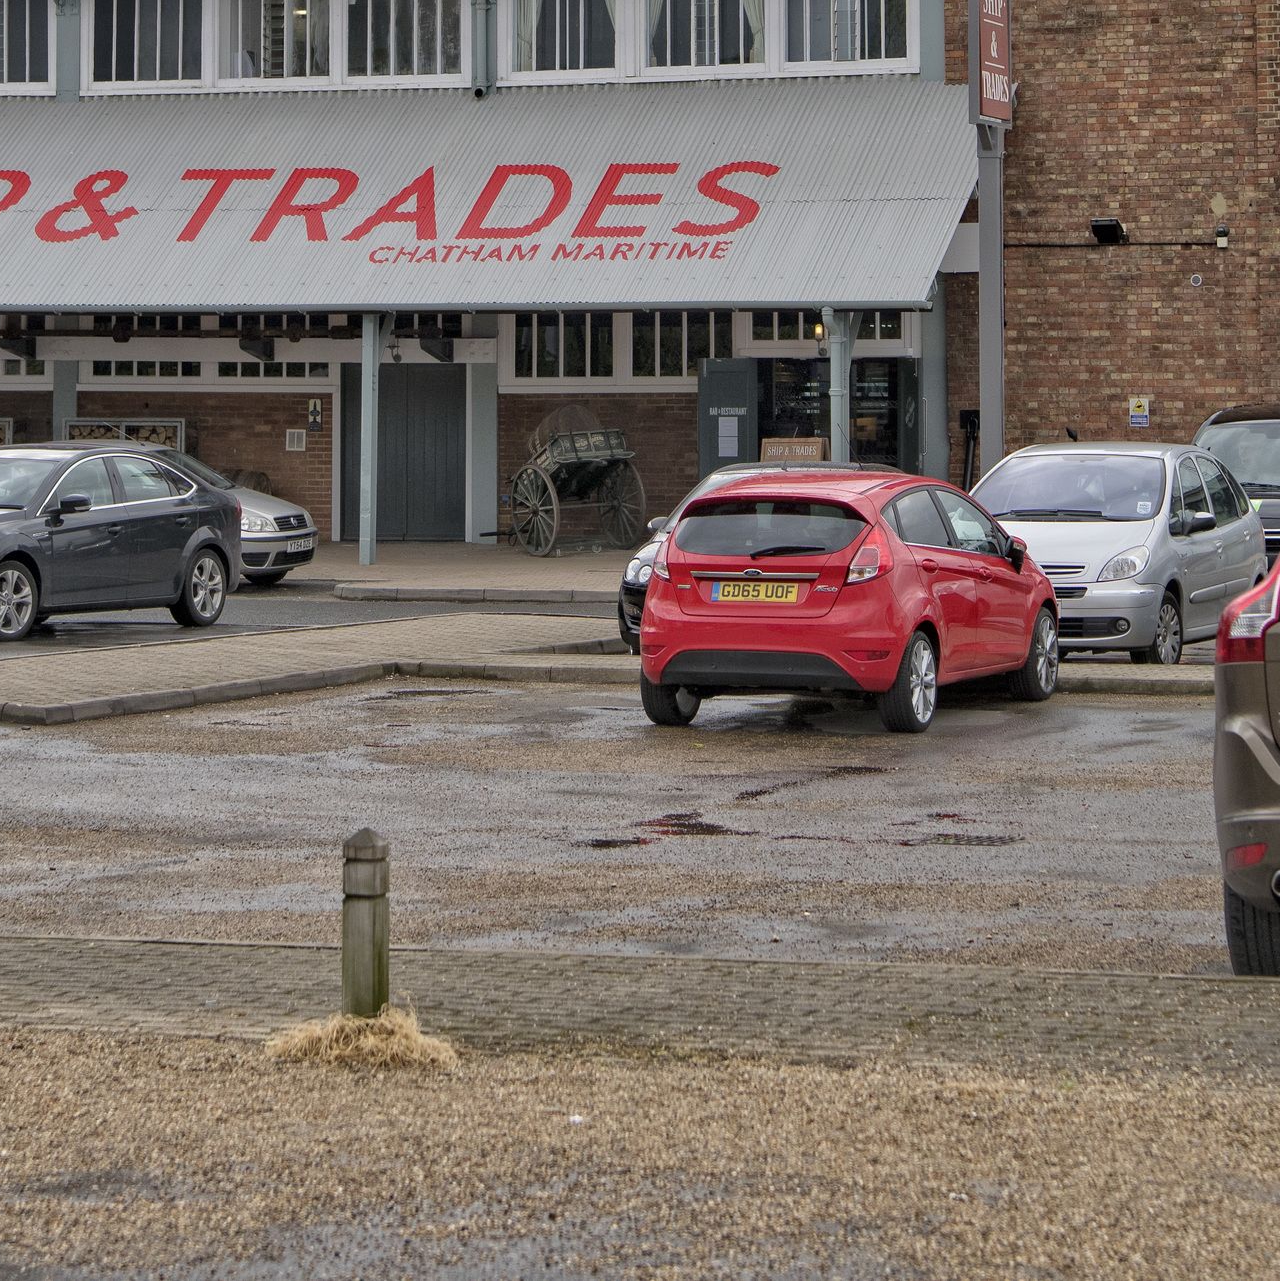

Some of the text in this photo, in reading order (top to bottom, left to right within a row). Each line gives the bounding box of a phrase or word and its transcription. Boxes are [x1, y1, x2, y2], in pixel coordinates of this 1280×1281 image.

[990, 30, 998, 59] &
[981, 70, 1009, 103] TRADES
[34, 169, 140, 243] &
[176, 160, 782, 243] TRADES
[368, 239, 735, 266] CHATHAM MARITIME
[767, 445, 817, 456] SHIP & TRADES
[721, 583, 795, 599] GD65 UOF
